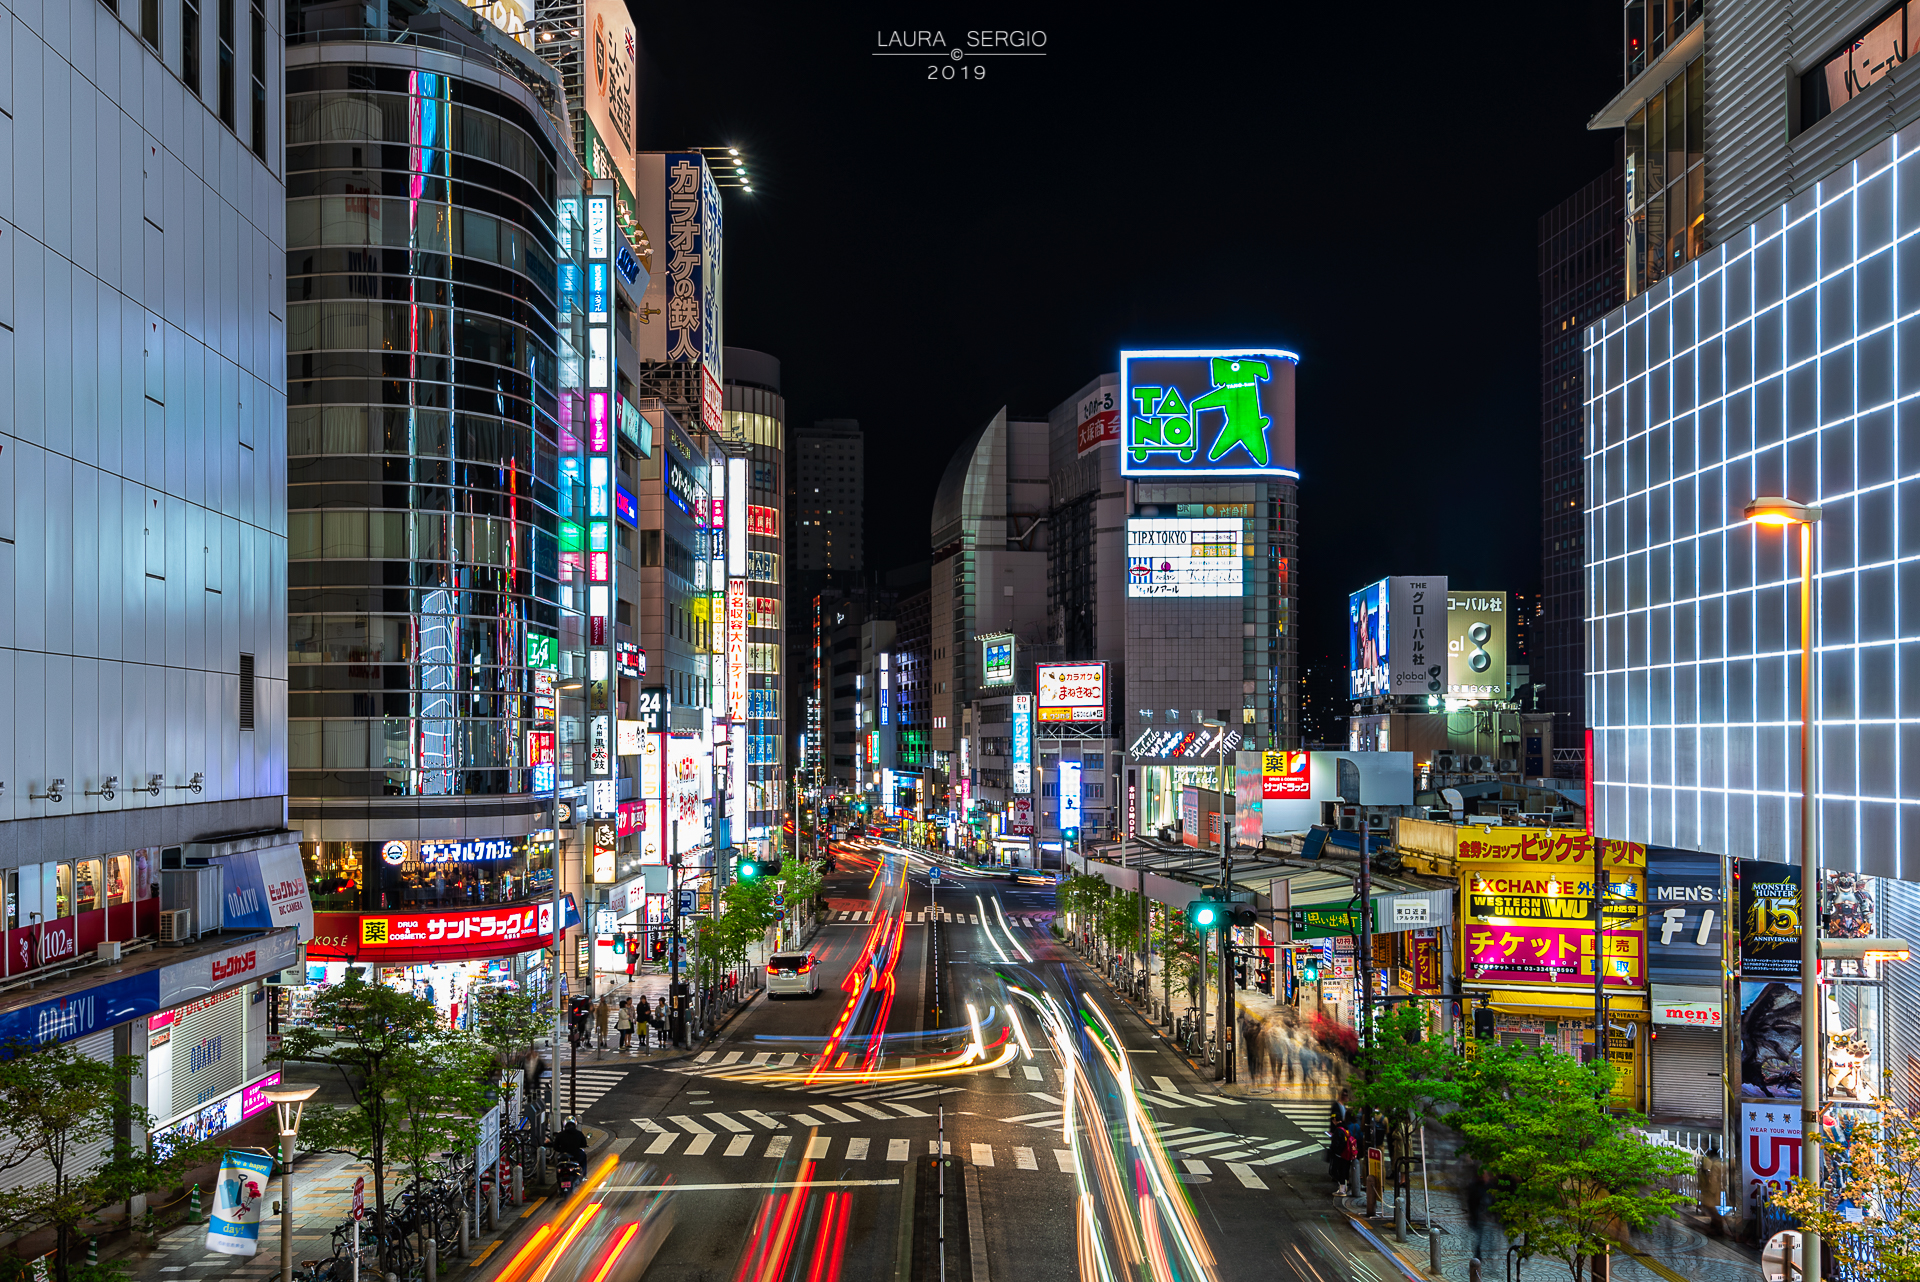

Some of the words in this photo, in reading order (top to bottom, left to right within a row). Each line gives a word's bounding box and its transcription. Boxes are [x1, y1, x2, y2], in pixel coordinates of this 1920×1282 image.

[669, 160, 701, 360] カラオケの鉄人
[1156, 531, 1187, 544] TOKYO
[1412, 591, 1425, 666] グローバル社
[1396, 671, 1427, 686] global
[1059, 685, 1101, 700] まねきねこ
[640, 693, 661, 712] 24
[643, 712, 657, 728] H
[593, 738, 606, 770] 黒太鼓
[1265, 754, 1284, 773] 薬
[1172, 772, 1219, 784] Kaleido
[1264, 782, 1310, 792] サンドラッグ
[421, 840, 512, 863] サンマルクカフェ
[267, 878, 306, 902] ビックカメラ
[1657, 884, 1713, 901] MEN'S
[1752, 883, 1797, 891] MONSTER
[227, 887, 259, 918] ODAKYU
[278, 905, 287, 916] BIC
[286, 901, 304, 914] CAMERA
[1474, 896, 1541, 908] WESTERN
[1494, 907, 1541, 917] UNION
[364, 921, 388, 943] 薬
[427, 913, 522, 940] サンドラッグ
[314, 933, 349, 948] KOSÉ
[389, 932, 427, 941] COSMETIC
[1469, 930, 1578, 959] チケット
[212, 950, 256, 982] ビックカメラ
[1417, 941, 1429, 985] チケット
[38, 995, 95, 1045] ODAKYU
[1665, 1007, 1721, 1021] men's
[1750, 1135, 1803, 1178] UT
[248, 1162, 268, 1173] happy
[222, 1221, 245, 1237] day!
